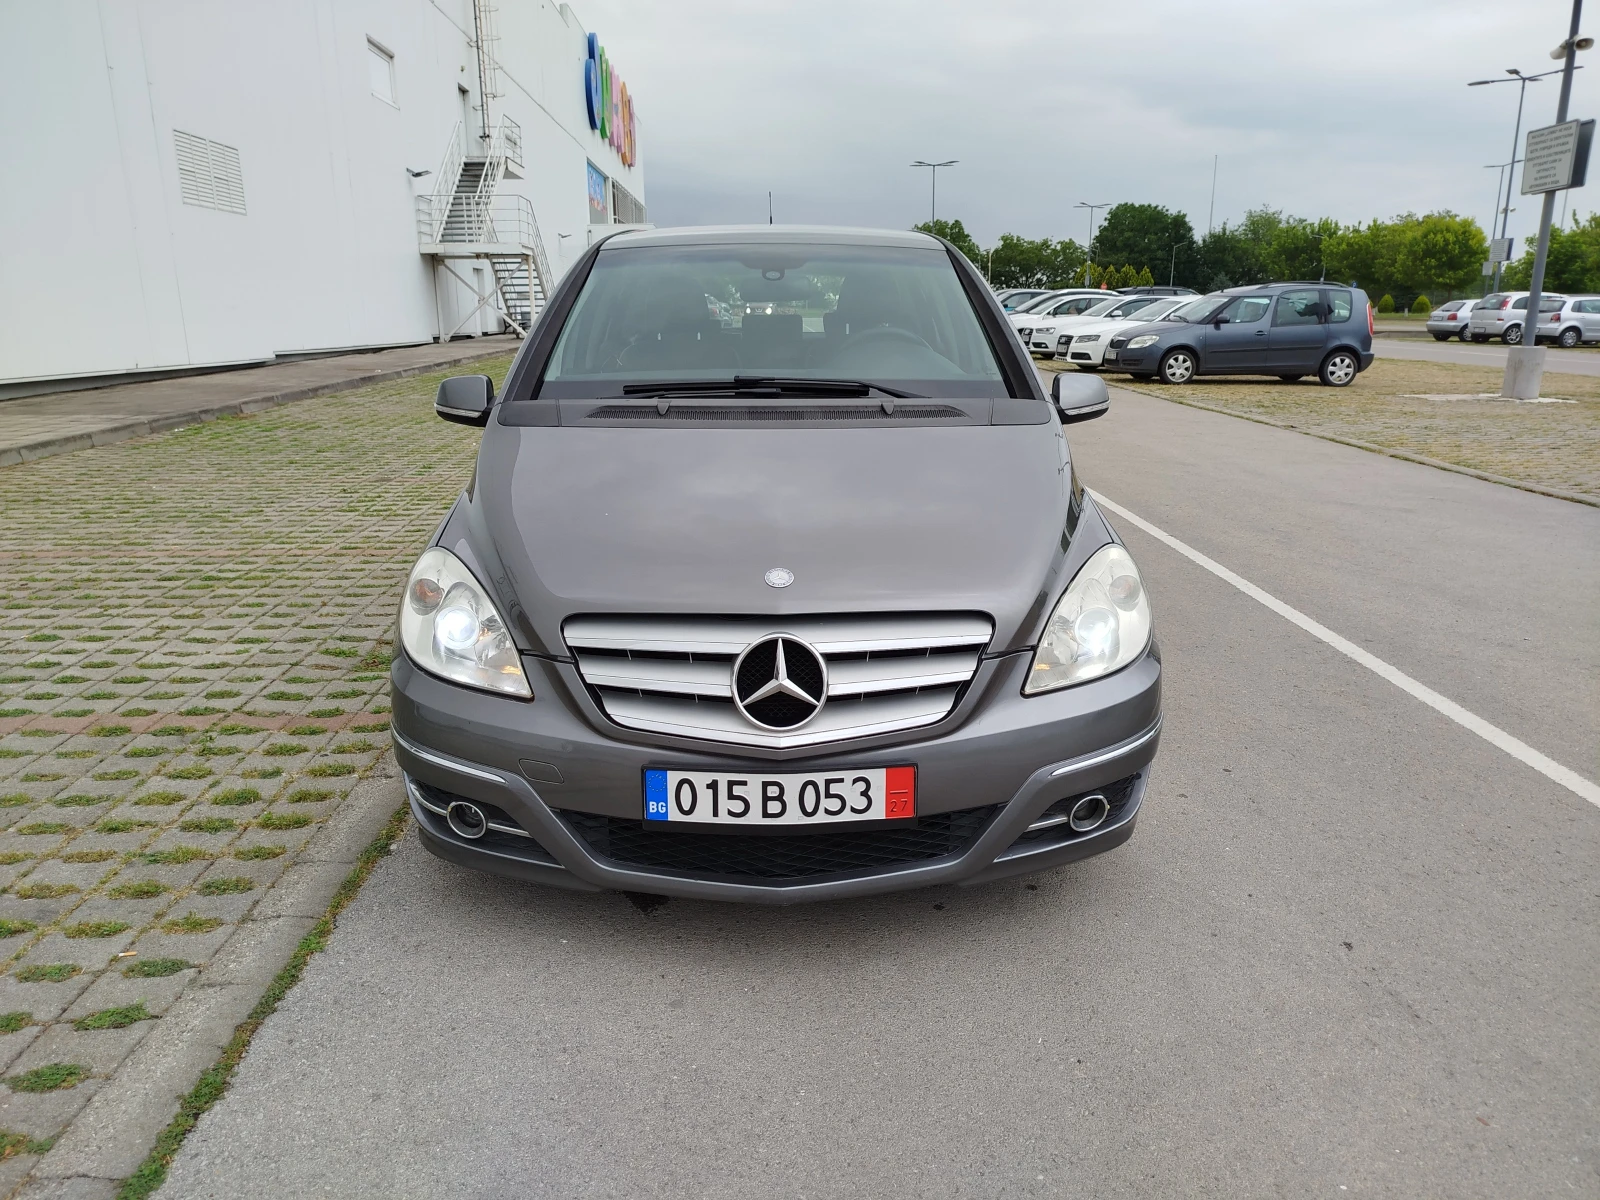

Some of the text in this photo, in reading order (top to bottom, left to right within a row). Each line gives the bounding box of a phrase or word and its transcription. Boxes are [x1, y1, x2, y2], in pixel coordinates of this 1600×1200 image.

[674, 776, 873, 819] 015 B 053
[649, 801, 667, 813] BG
[889, 798, 909, 813] 27
